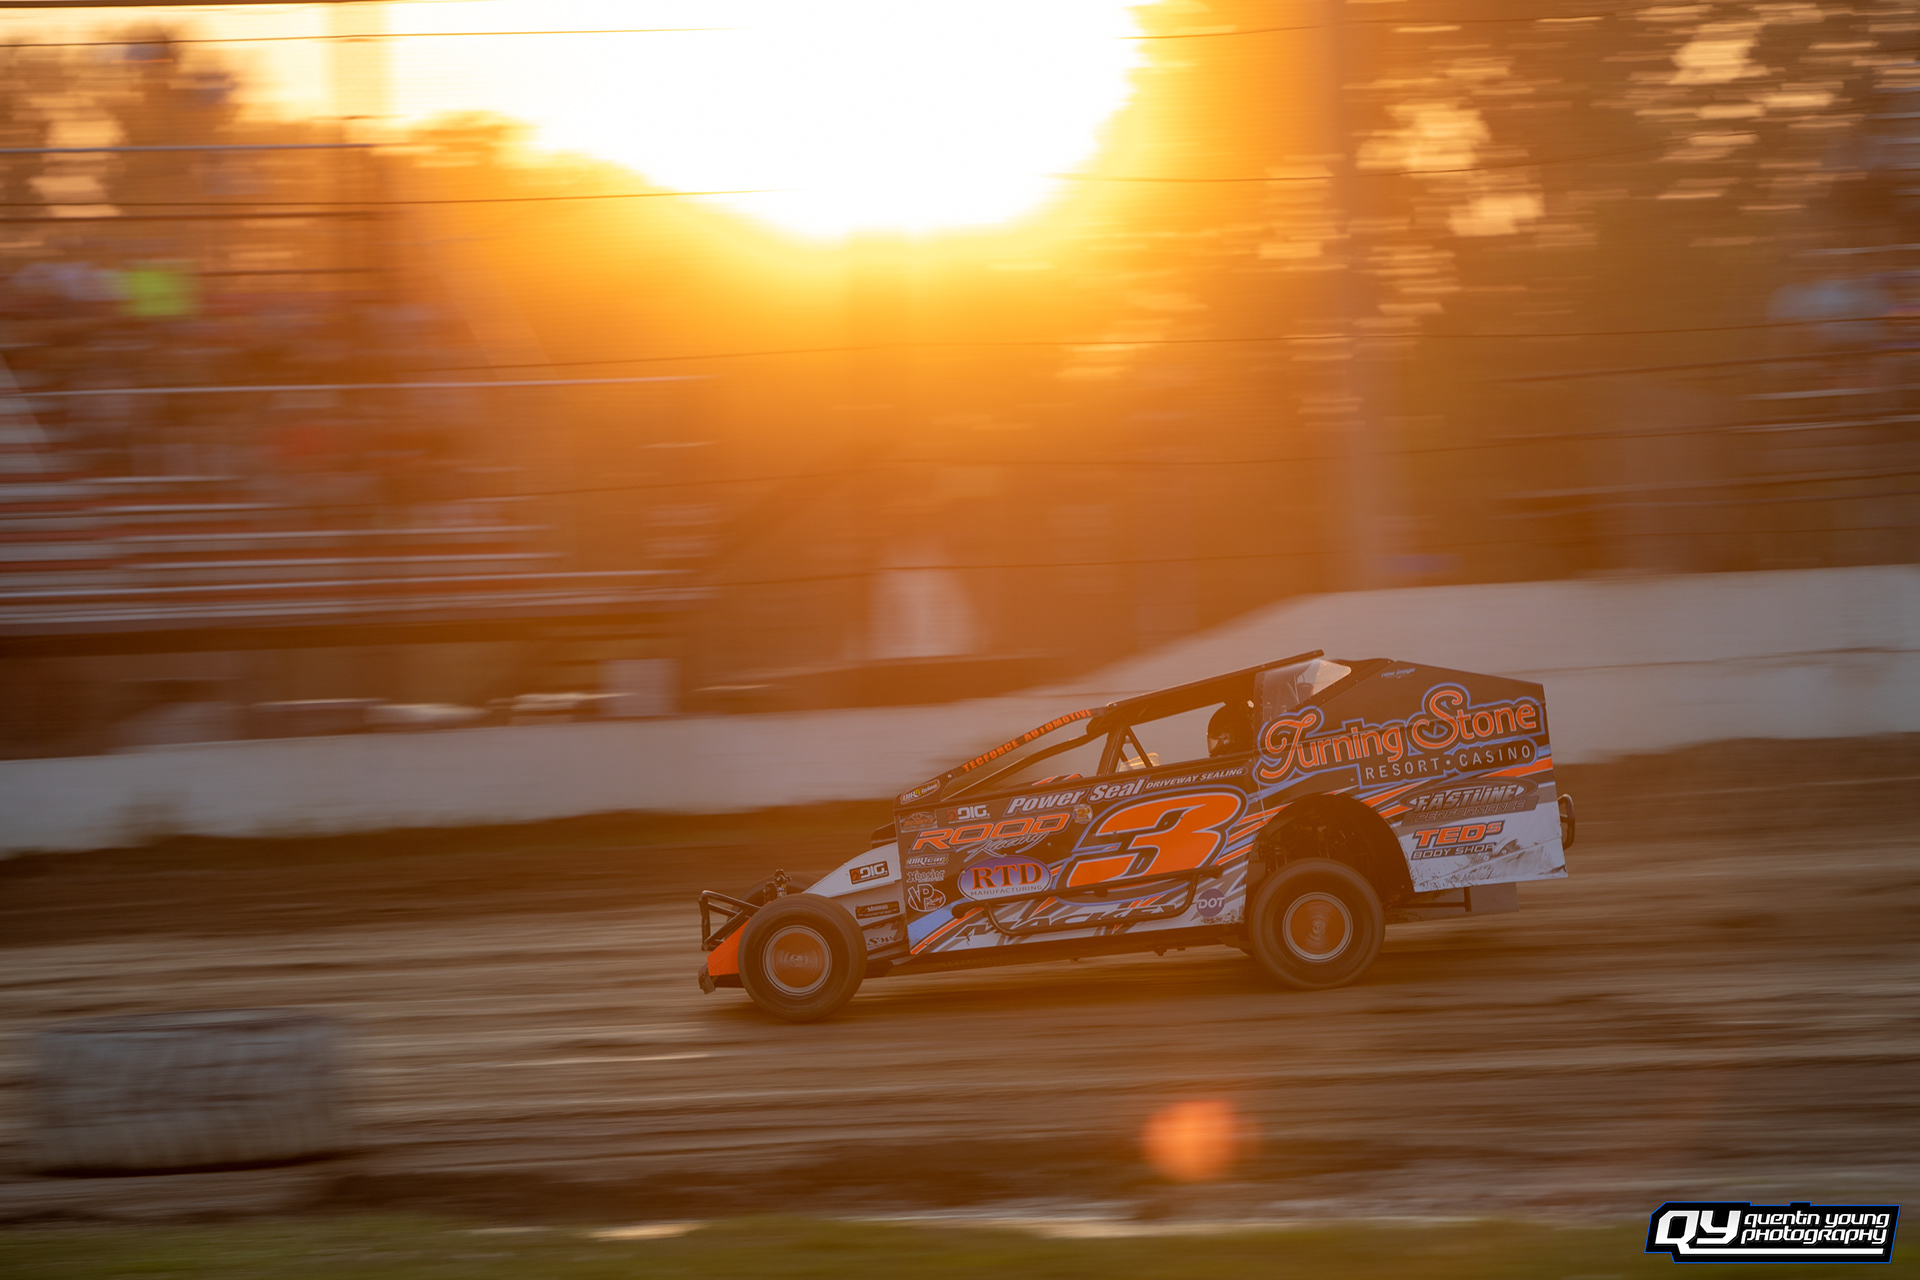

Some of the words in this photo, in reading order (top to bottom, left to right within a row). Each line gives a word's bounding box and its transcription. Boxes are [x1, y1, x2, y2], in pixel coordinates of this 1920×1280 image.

[962, 739, 1019, 772] TECFORCE
[1023, 708, 1092, 742] AUTOMOTIVE
[1260, 713, 1402, 778] Turning
[1412, 690, 1537, 748] Stone
[1365, 757, 1440, 780] RESORT
[1459, 744, 1531, 768] CASINO
[1007, 789, 1086, 814] Power
[1090, 779, 1144, 802] Seal
[1146, 774, 1199, 789] DRIVEWAY
[1200, 767, 1244, 782] SEALING
[1414, 784, 1517, 811] FASTLINE
[1415, 800, 1527, 822] PERFORMANCE
[912, 813, 1071, 850] ROOD
[1067, 791, 1242, 888] 3
[1412, 848, 1451, 860] BODY
[1455, 843, 1496, 855] SHOP
[906, 869, 945, 882] Hoosier
[970, 863, 1043, 890] RTD
[908, 883, 934, 911] VP
[970, 885, 1043, 896] MANUFACTURING
[1198, 897, 1225, 909] DOT
